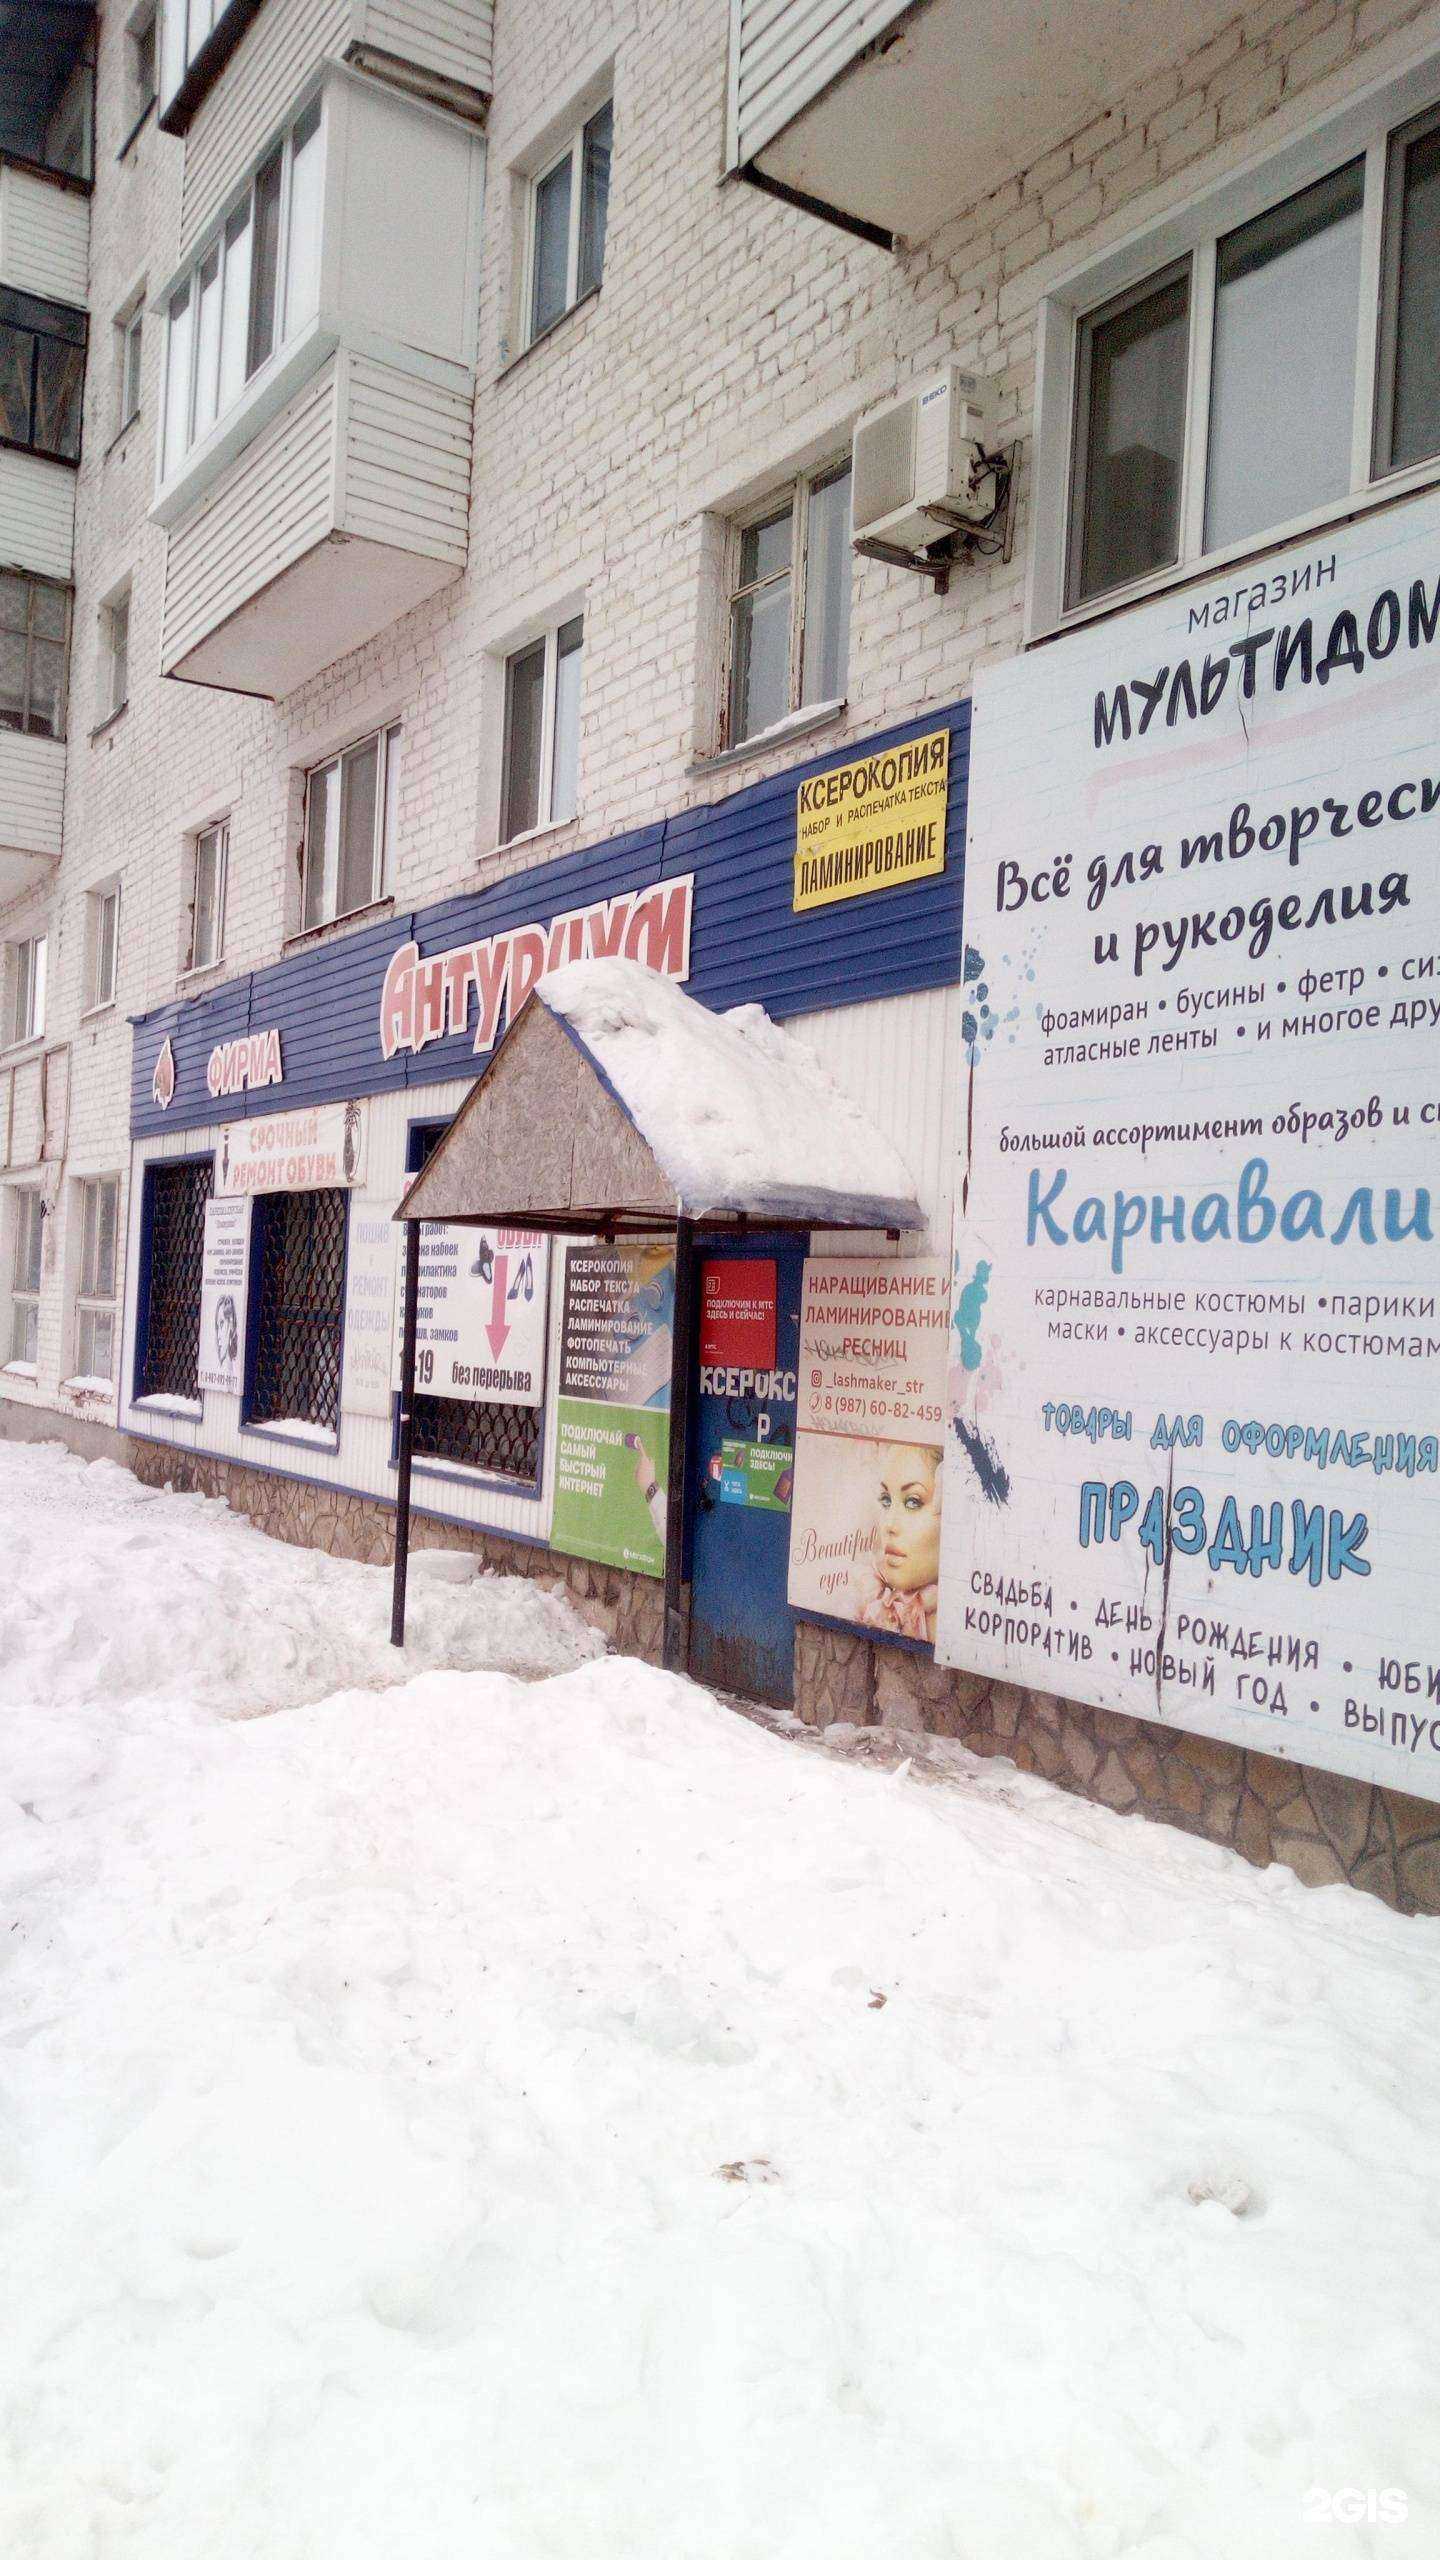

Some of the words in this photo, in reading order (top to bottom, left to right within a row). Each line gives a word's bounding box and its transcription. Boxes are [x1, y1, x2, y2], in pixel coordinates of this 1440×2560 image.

[1188, 554, 1336, 634] магазин
[1094, 572, 1440, 748] МУЛЬТИДОМ
[800, 736, 945, 814] КСЕРОКОПИЯ
[801, 817, 831, 840] НАБОР
[836, 815, 843, 827] И
[847, 790, 906, 822] РАСПЕЧАТКА
[908, 778, 945, 801] ТЕКСТА
[800, 821, 937, 896] ЛАМИНИРОВАНИЕ
[996, 854, 1072, 912] Всё
[1086, 845, 1164, 911] для
[1094, 930, 1120, 964] и
[1133, 872, 1411, 976] рукоделия
[1041, 1002, 1149, 1038] фоамиран
[1176, 981, 1265, 1018] бусины
[1298, 967, 1364, 1002] фетр
[1043, 1035, 1141, 1066] атласные
[1147, 1027, 1218, 1057] ленты
[1258, 1021, 1271, 1041] и
[1282, 1005, 1381, 1038] многое
[208, 1030, 282, 1094] ФИРМА
[999, 1125, 1086, 1153] большой
[1093, 1118, 1263, 1153] ассортимент
[1271, 1095, 1383, 1142] образов
[1393, 1106, 1410, 1125] и
[1420, 1103, 1440, 1124] с
[233, 1158, 285, 1187] РЕМОНТ
[287, 1153, 336, 1184] ОБУВИ
[570, 1259, 634, 1273] КСЕРОКОПИЯ
[570, 1280, 600, 1293] НАБОР
[604, 1279, 640, 1293] ТЕКСТА
[809, 1276, 936, 1298] НАРАЩИВАНИЕ
[1034, 1287, 1186, 1317] карнавальные
[1195, 1292, 1306, 1315] костюмы
[569, 1298, 630, 1313] РАСПЕЧАТКА
[567, 1317, 653, 1335] ЛАМИНИРОВАНИЕ
[1048, 1320, 1109, 1342] маски
[1134, 1323, 1268, 1353] аксессуары
[1280, 1330, 1292, 1351] к
[567, 1337, 632, 1354] ФОТОПЕЧАТЬ
[842, 1337, 908, 1362] РЕСНИЦ
[451, 1361, 471, 1386] без
[472, 1364, 532, 1392] перерыва
[565, 1373, 629, 1392] АКСЕССУАРЫ
[566, 1356, 649, 1376] КОМПЬЮТЕРНЫЕ
[700, 1366, 796, 1402] КСЕРОКС
[826, 1371, 924, 1396] _lashmaker_str
[825, 1396, 832, 1410] 8
[835, 1396, 866, 1418] (987)
[870, 1401, 943, 1422] 60-82-459
[560, 1441, 597, 1460] САМЫЙ
[561, 1423, 624, 1447] ПОДКЛЮЧАЙ
[1042, 1402, 1132, 1443] ТОВАРЫ
[1150, 1413, 1204, 1450] ДЛЯ
[1222, 1419, 1440, 1478] ОФОРМЛЕНИЯ
[559, 1459, 606, 1480] БЫСТРЫЙ
[559, 1477, 605, 1498] ИНТЕРНЕТ
[791, 1526, 879, 1566] Beautiful
[1079, 1480, 1373, 1587] ПРАЗДНИК
[819, 1571, 850, 1596] eyes
[971, 1570, 1054, 1617] СВАДЬБА
[1095, 1598, 1153, 1632] ДЕНЬ
[1178, 1614, 1320, 1670] РОЖДЕНИЯ
[964, 1606, 1094, 1660] КОРПОРАТИВ
[1130, 1647, 1216, 1697] НОВЫЙ
[1237, 1673, 1288, 1716] ГОД
